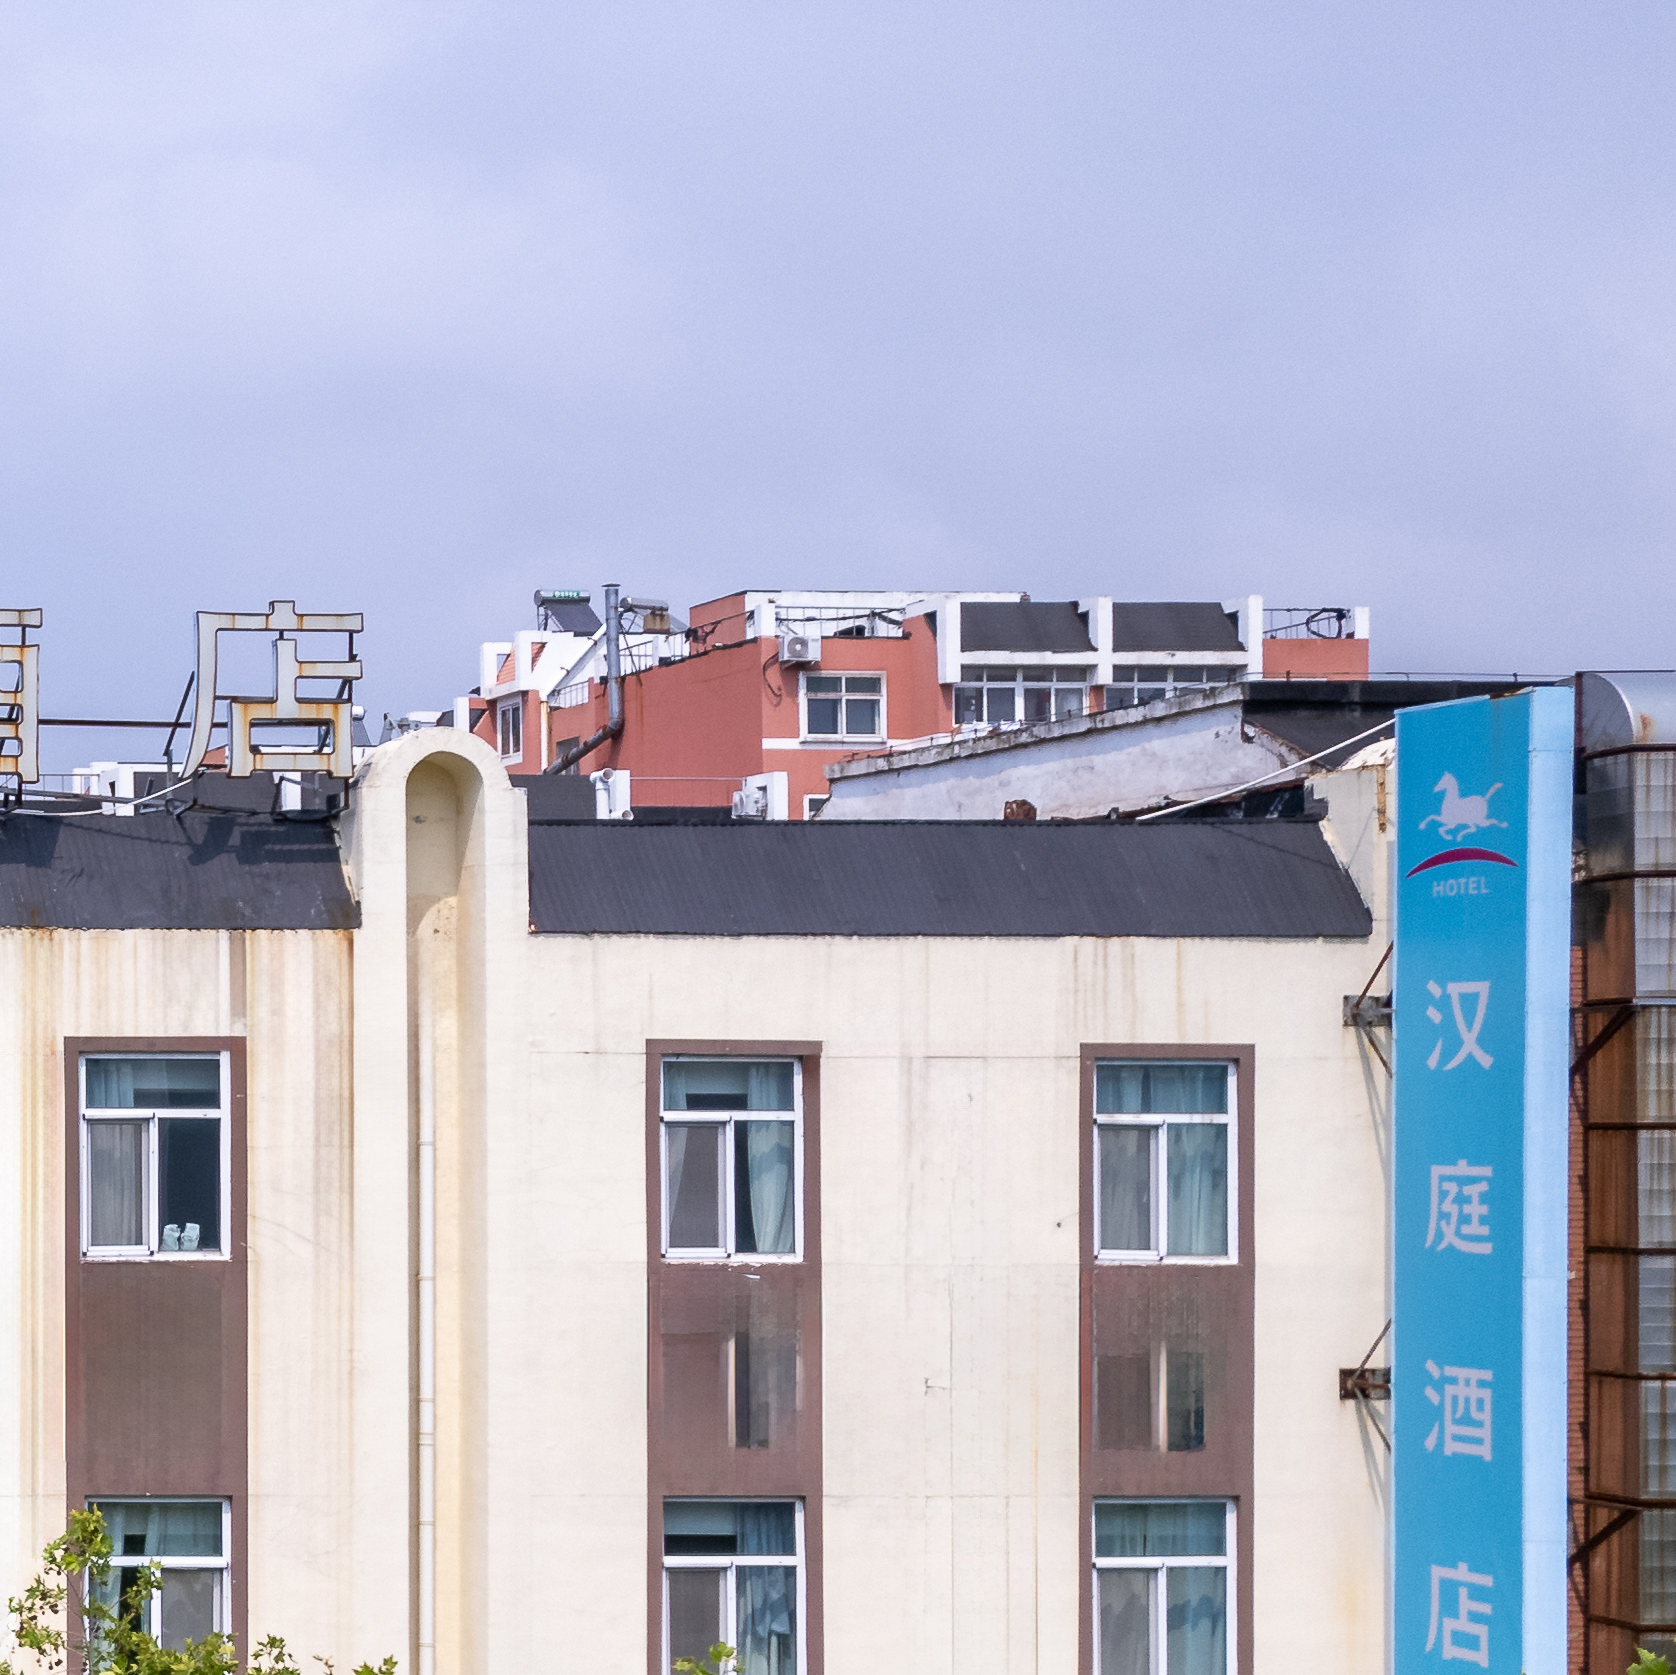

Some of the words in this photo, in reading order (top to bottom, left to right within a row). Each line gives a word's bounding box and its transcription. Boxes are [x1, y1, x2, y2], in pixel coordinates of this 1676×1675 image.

[1432, 876, 1490, 898] HOTEL
[1425, 979, 1494, 1668] 汉庭酒店
